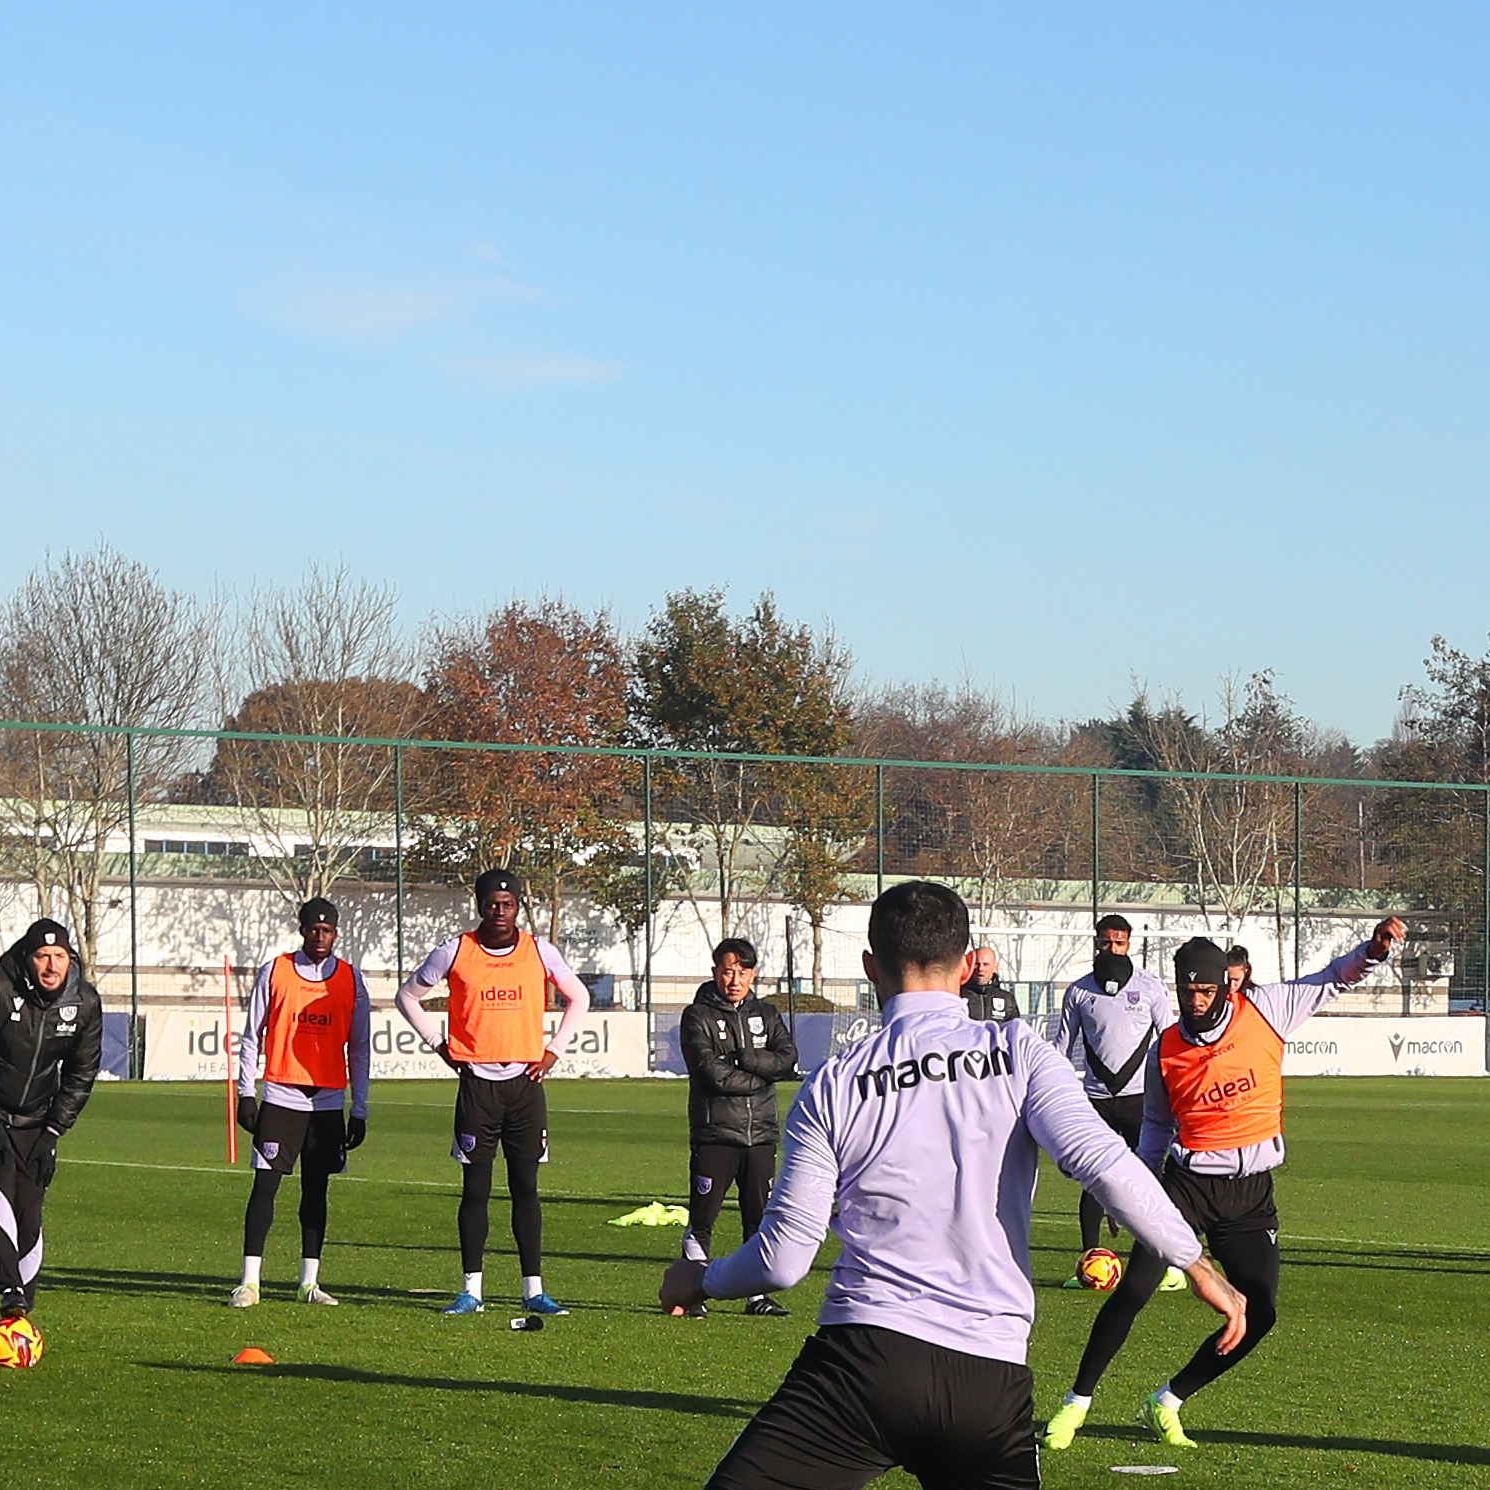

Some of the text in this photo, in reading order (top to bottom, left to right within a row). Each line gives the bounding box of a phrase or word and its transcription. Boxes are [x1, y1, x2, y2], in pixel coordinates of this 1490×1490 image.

[480, 985, 522, 1001] ideal
[292, 1009, 333, 1026] ideal
[1199, 1043, 1235, 1064] macron
[1284, 1040, 1338, 1055] macron
[1407, 1040, 1463, 1054] macron
[856, 1047, 1013, 1101] macron
[1201, 1068, 1257, 1106] ideal
